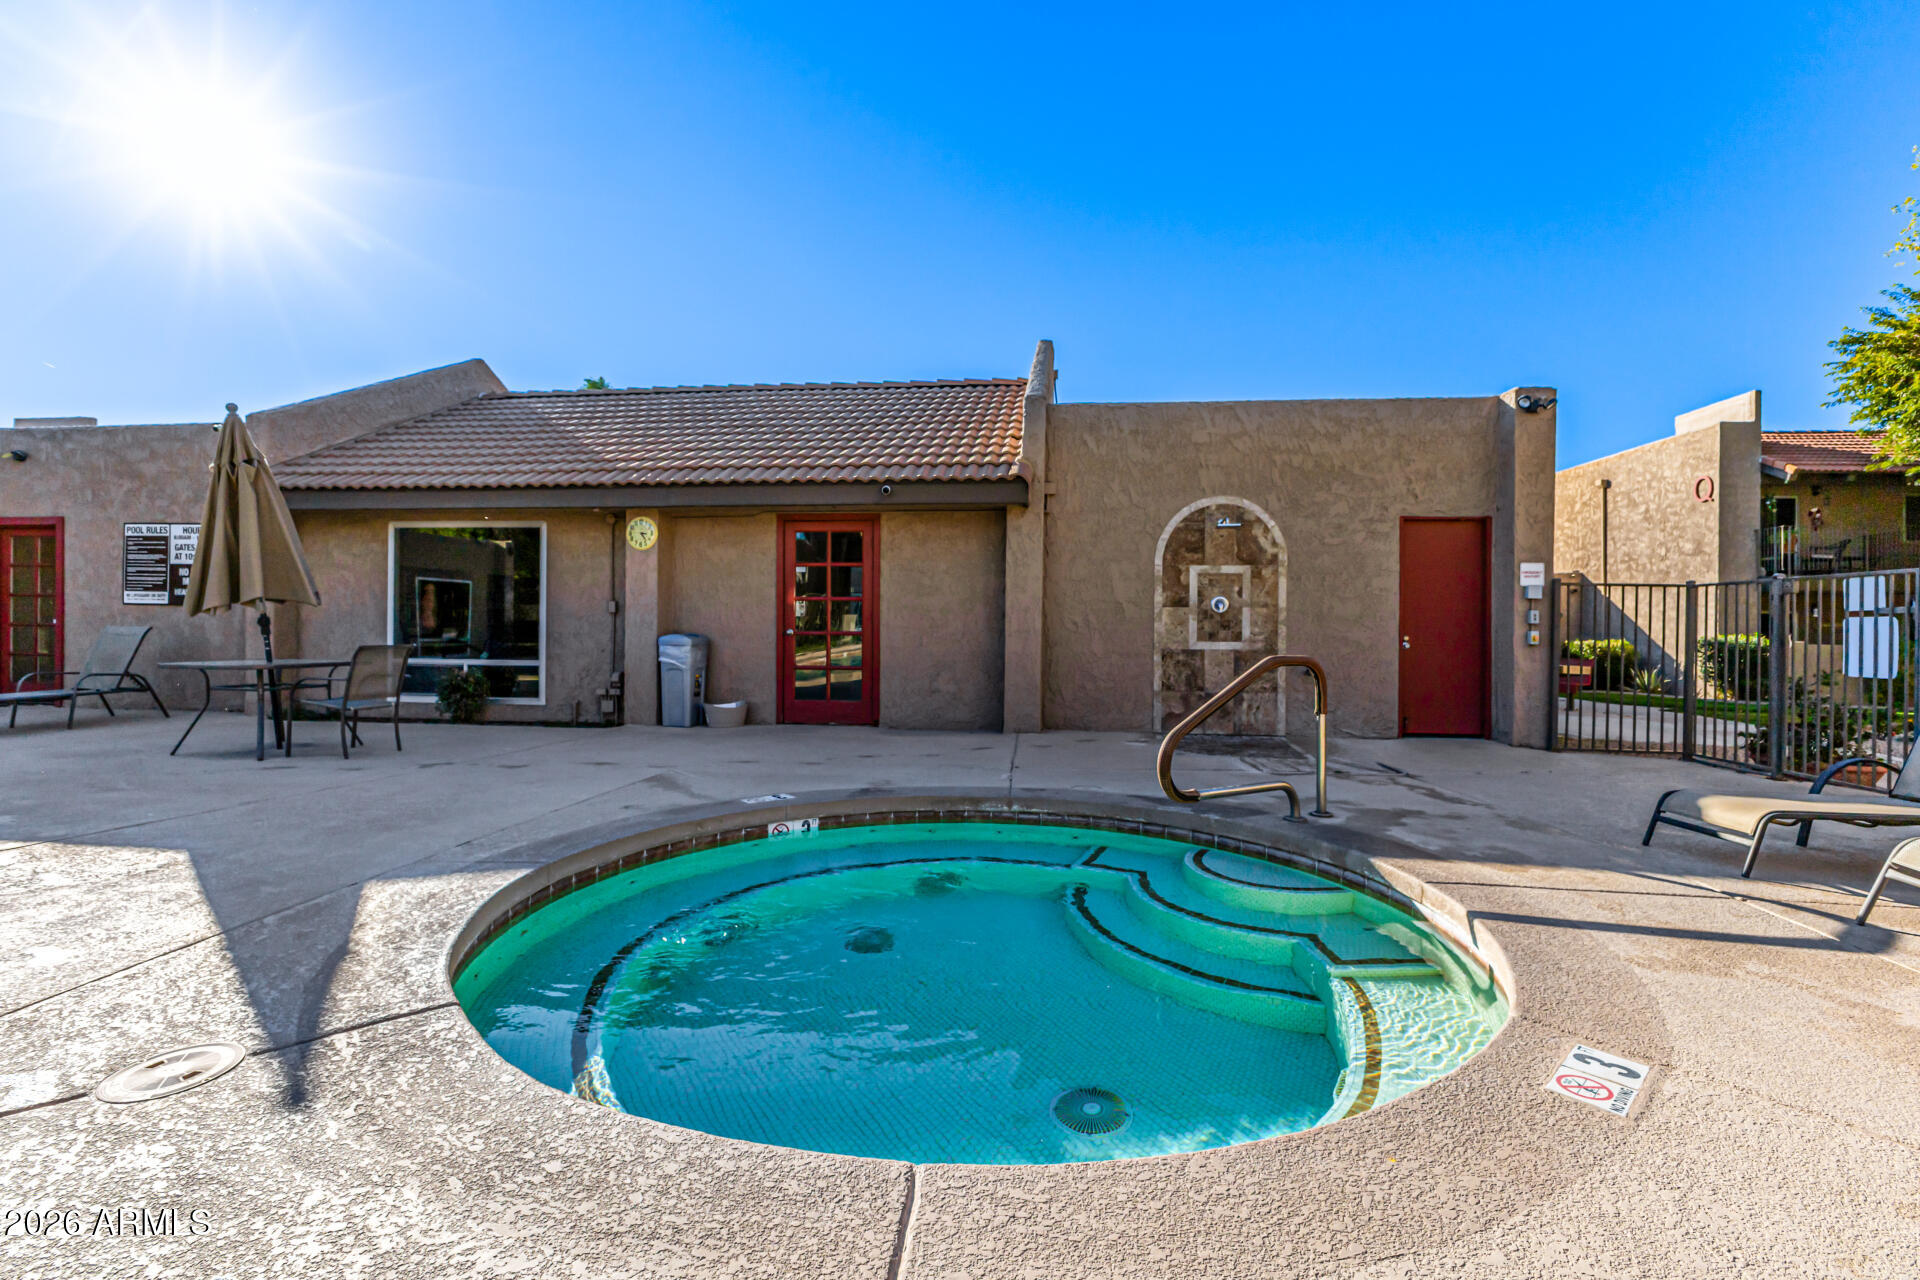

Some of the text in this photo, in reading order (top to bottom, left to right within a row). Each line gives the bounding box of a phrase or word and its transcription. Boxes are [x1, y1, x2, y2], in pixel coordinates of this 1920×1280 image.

[1693, 475, 1714, 503] Q
[126, 526, 168, 534] POOL RULES
[174, 543, 196, 552] GATES
[1572, 1053, 1641, 1079] 3
